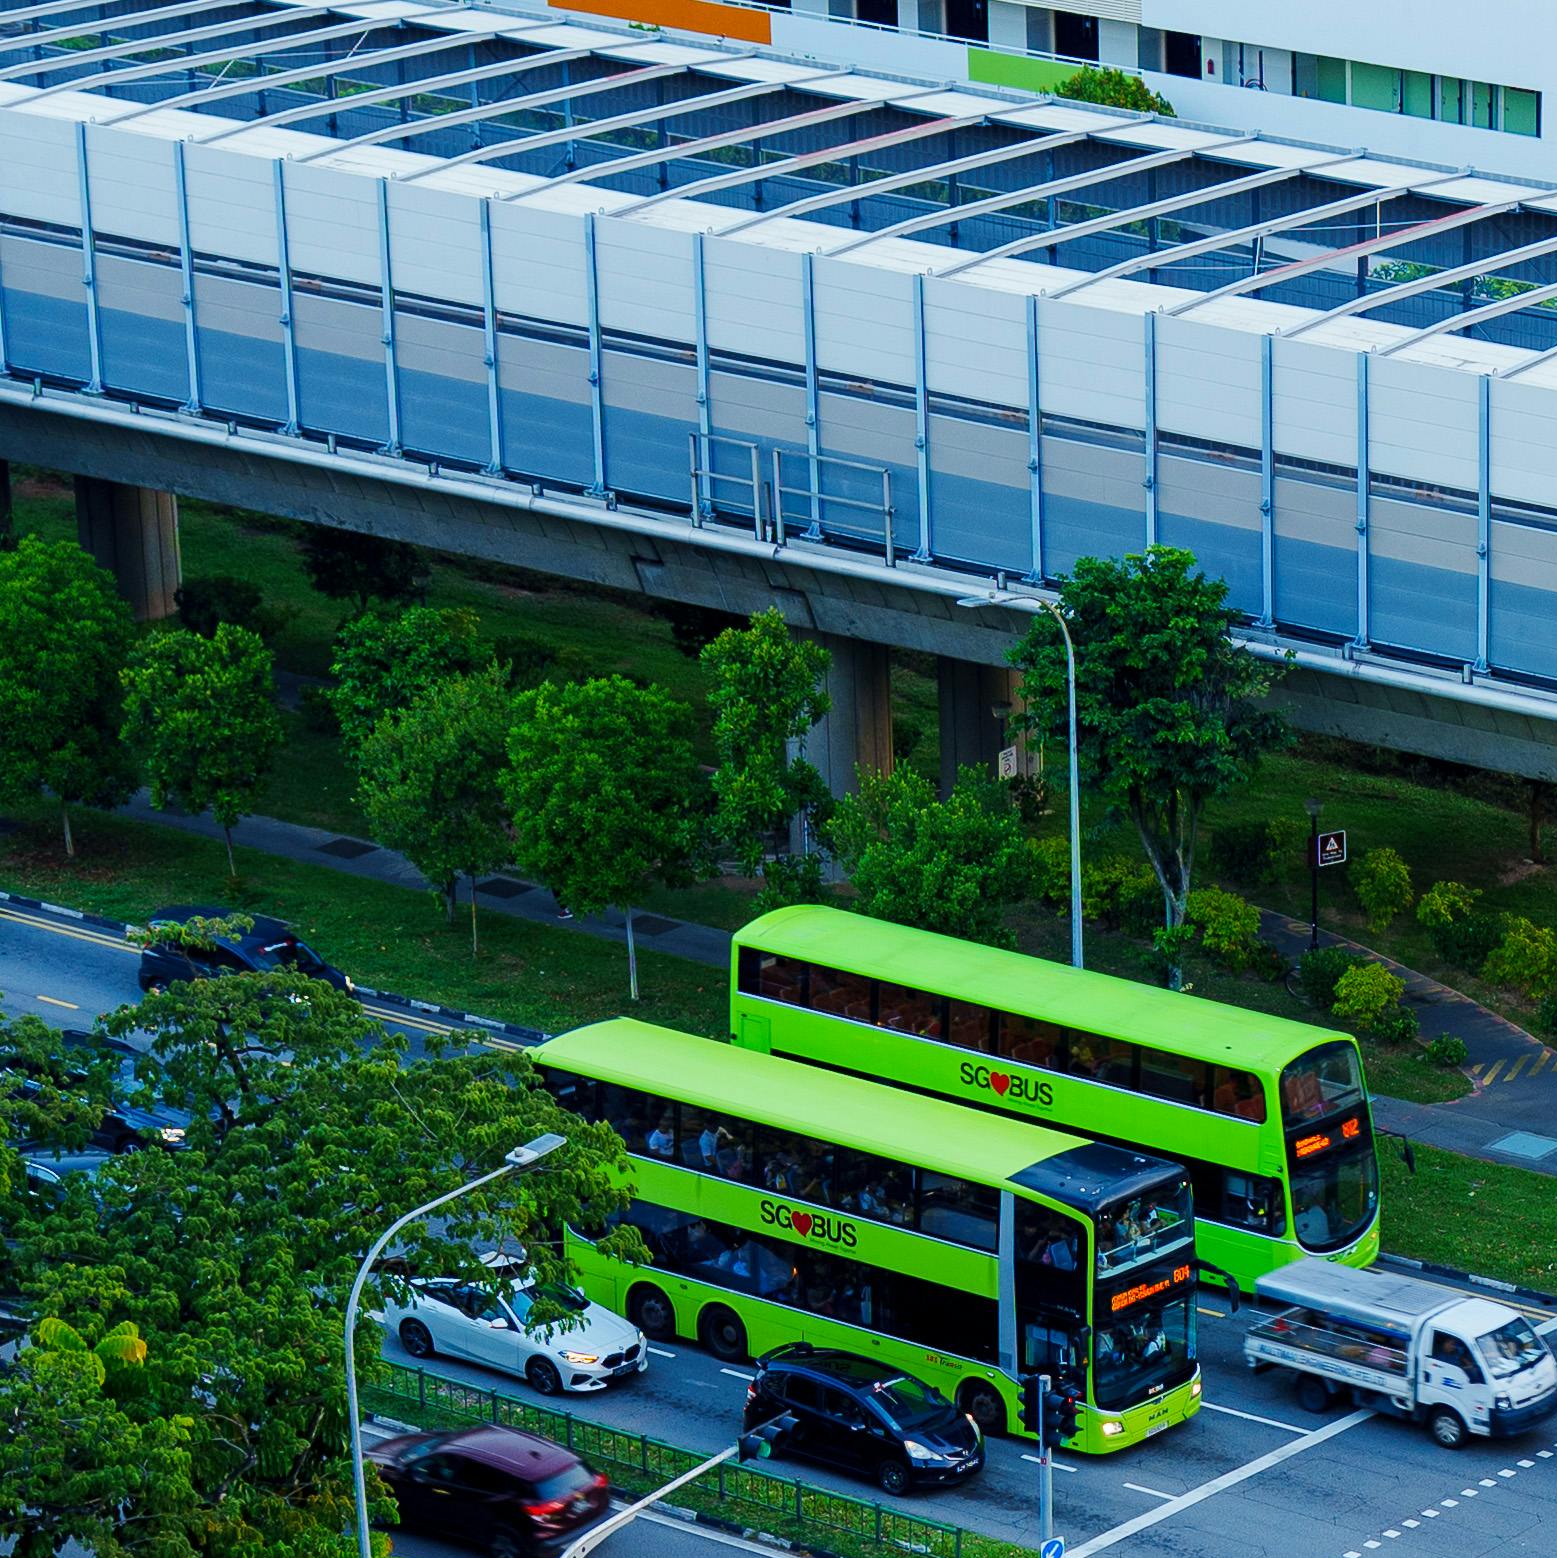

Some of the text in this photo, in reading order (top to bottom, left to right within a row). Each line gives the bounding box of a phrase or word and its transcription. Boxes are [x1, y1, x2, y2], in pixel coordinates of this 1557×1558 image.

[961, 1062, 991, 1089] SG
[1009, 1075, 1053, 1105] BUS
[760, 1199, 792, 1230] SG
[811, 1213, 857, 1248] BUS
